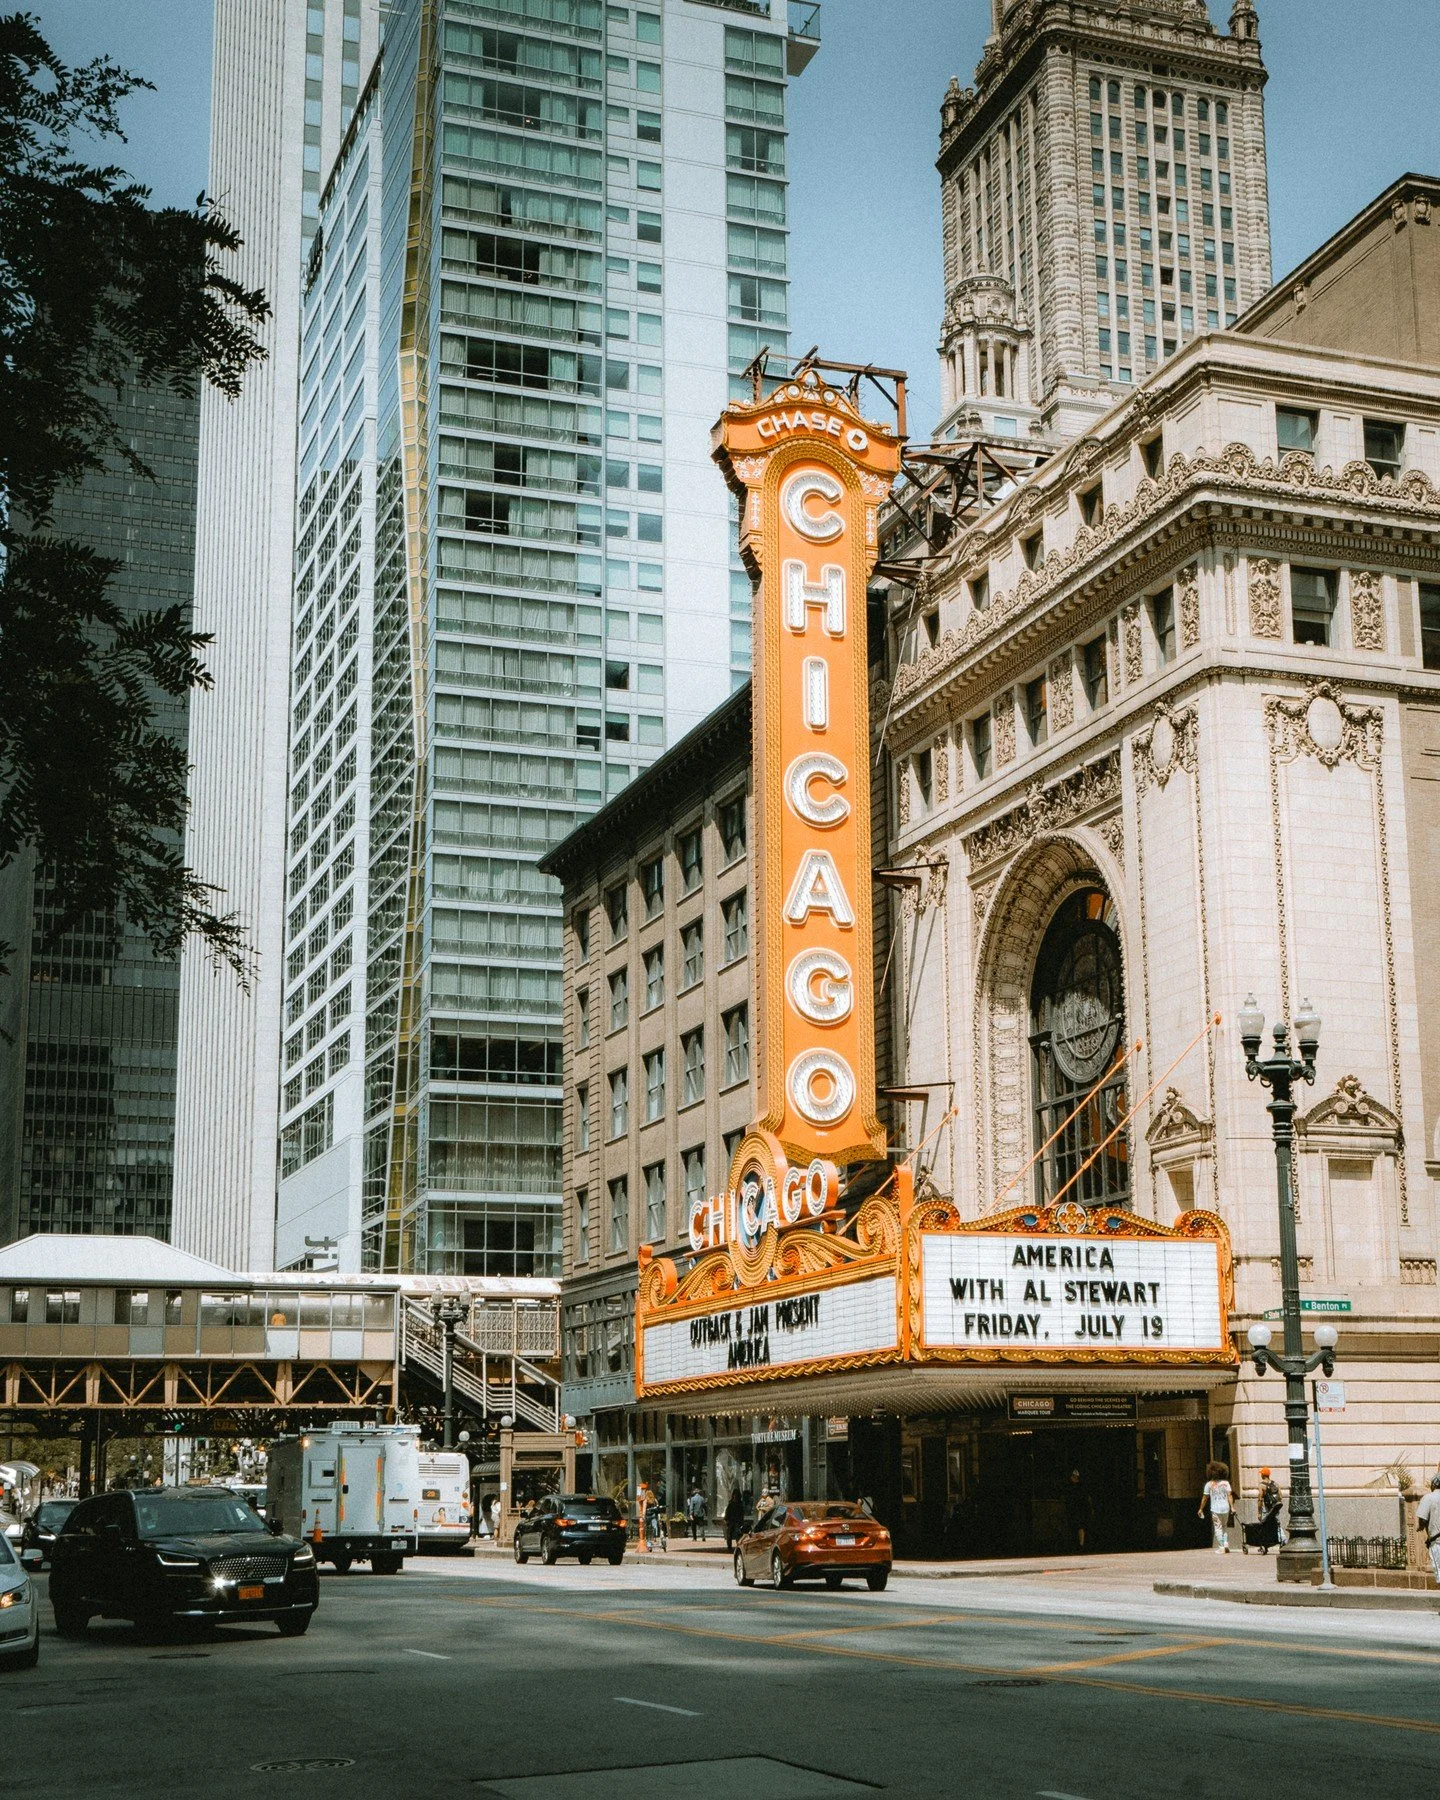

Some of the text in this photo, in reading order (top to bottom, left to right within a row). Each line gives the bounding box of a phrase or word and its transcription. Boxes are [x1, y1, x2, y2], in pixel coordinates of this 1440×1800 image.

[756, 410, 844, 438] CHASE
[781, 470, 855, 1125] CHICAGO
[689, 1158, 828, 1251] CHICAGO
[1012, 1245, 1114, 1269] AMERICA
[949, 1278, 1160, 1304] WITH AL STEWART
[747, 1304, 769, 1335] JAM
[775, 1293, 820, 1331] PRESENT
[1311, 1301, 1340, 1310] Benton
[965, 1313, 1163, 1339] FRIDAY, JULY 19
[727, 1336, 771, 1369] AMERICA
[1017, 1400, 1050, 1408] CHICAGO
[774, 1429, 797, 1441] MUSEUM
